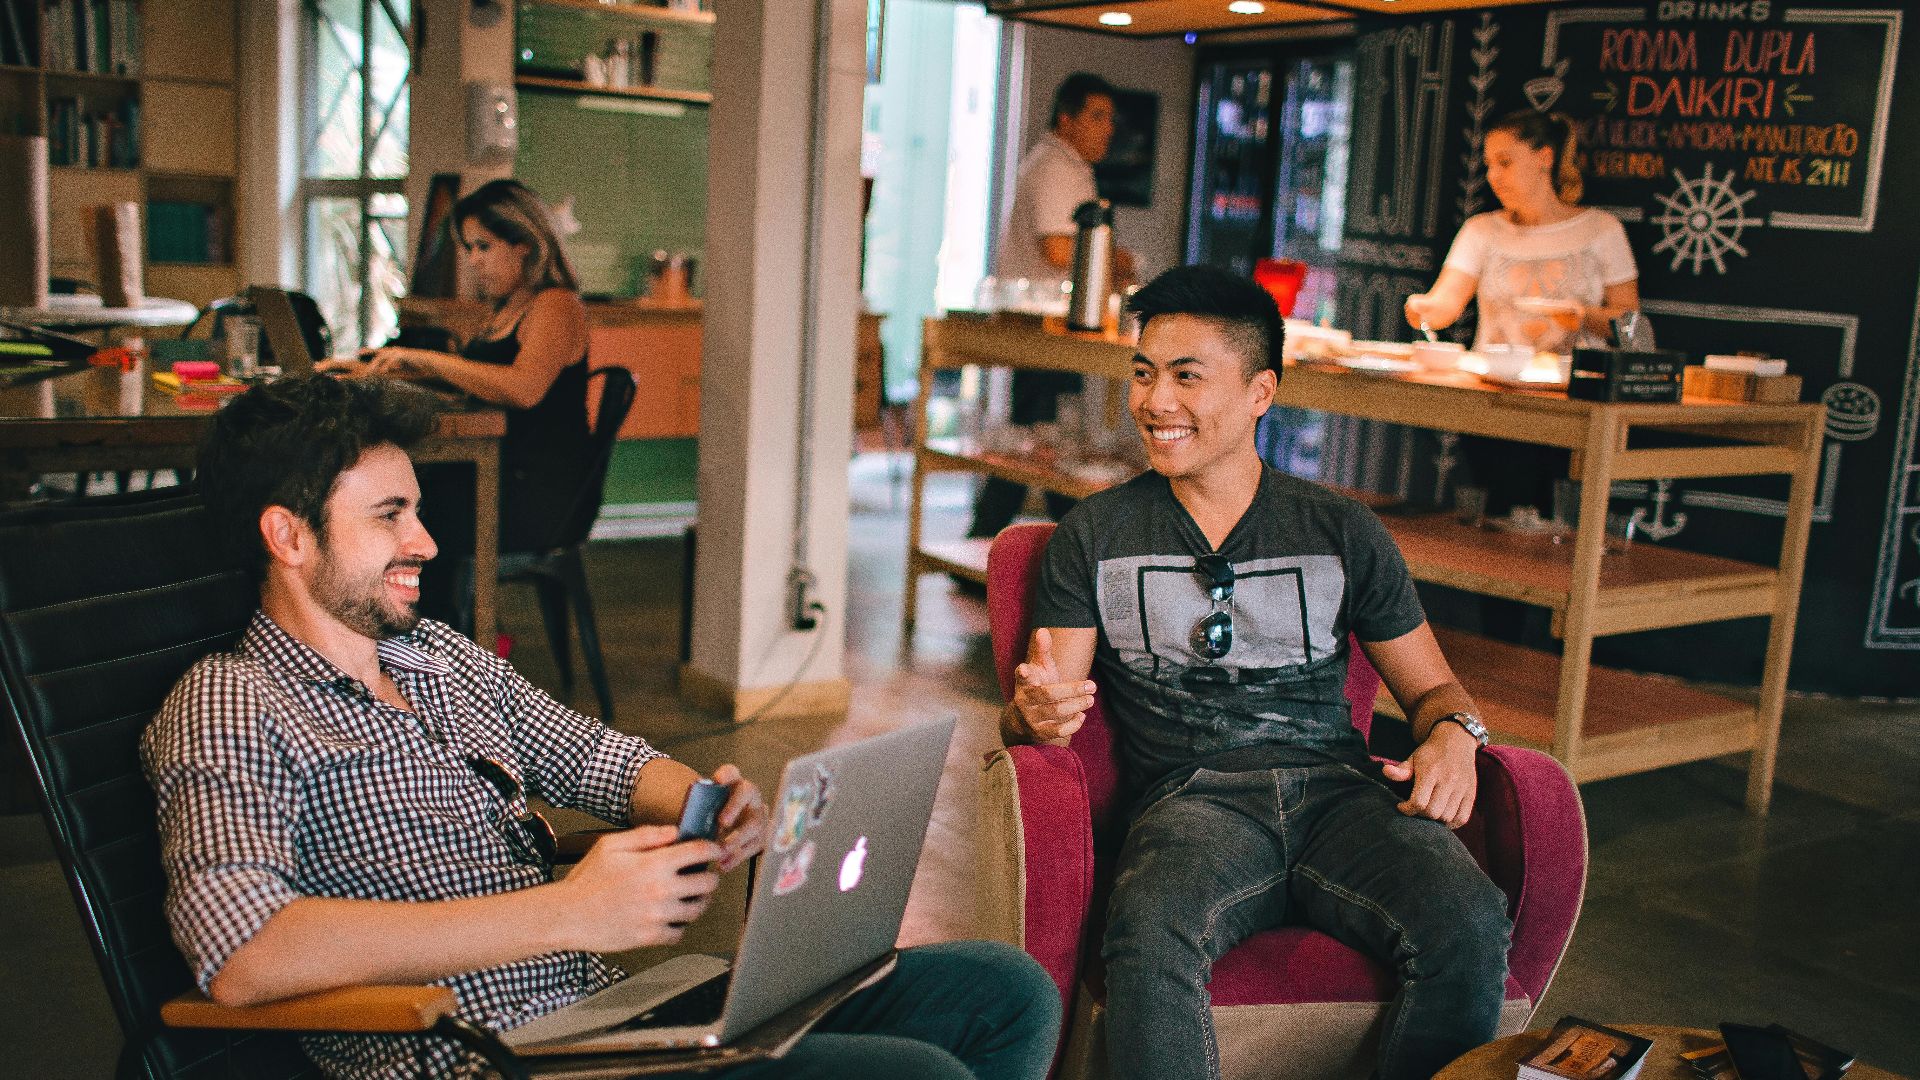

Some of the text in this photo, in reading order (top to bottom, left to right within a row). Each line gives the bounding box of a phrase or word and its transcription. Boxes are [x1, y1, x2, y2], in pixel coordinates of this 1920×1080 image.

[1657, 0, 1771, 22] DRINKS
[1721, 29, 1817, 75] DUPLA
[1627, 75, 1776, 119] DAIKIRI
